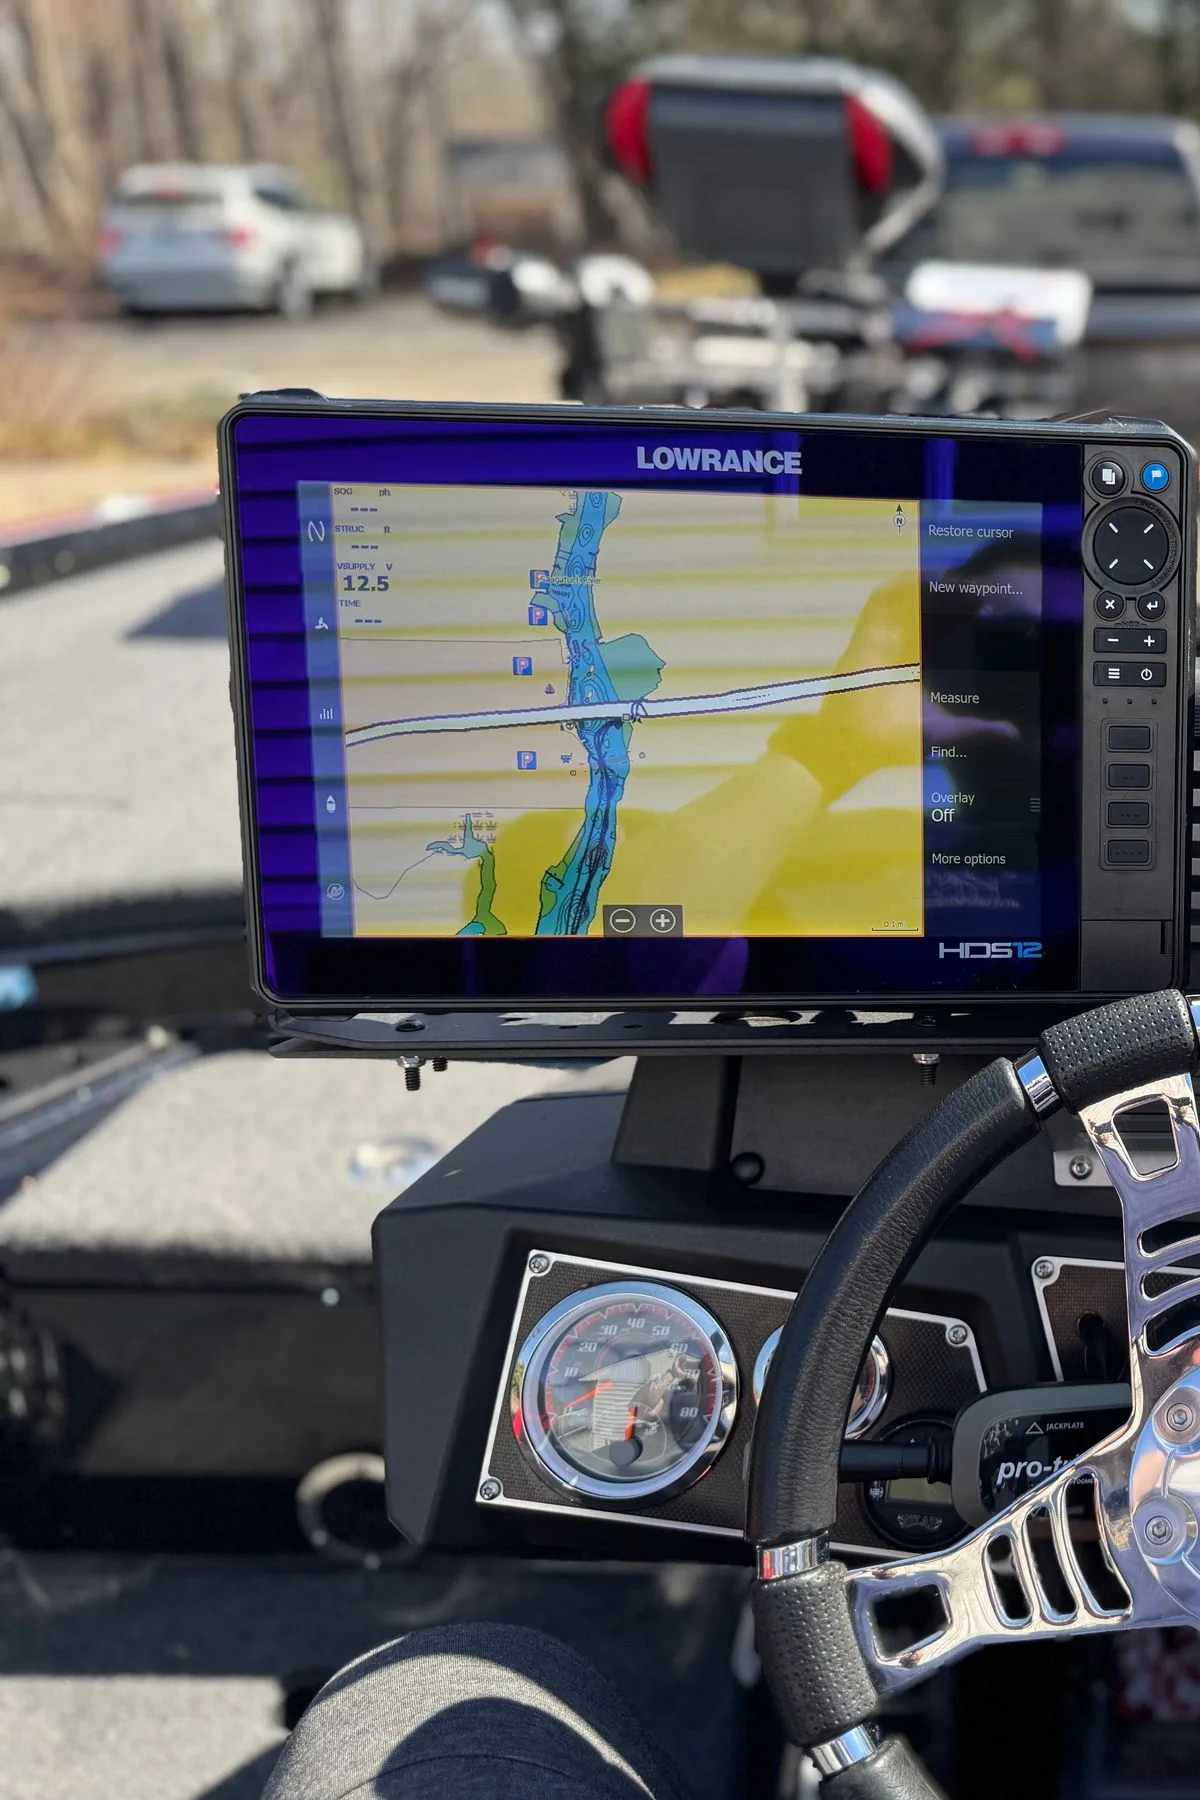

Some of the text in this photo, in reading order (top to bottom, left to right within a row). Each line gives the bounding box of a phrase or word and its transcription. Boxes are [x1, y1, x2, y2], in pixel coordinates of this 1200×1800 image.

[637, 446, 803, 475] LOWRANCE
[335, 525, 364, 533] STRUC
[928, 524, 1014, 538] Restore cursor
[386, 563, 393, 571] V
[343, 575, 389, 592] 12.5
[929, 581, 1023, 596] New waypoint...
[340, 599, 361, 607] TIME
[930, 691, 980, 704] Measure
[931, 747, 967, 758] Find...
[931, 791, 975, 806] Overlay
[932, 808, 955, 823] Off
[932, 853, 1006, 867] More options
[939, 942, 1042, 959] HDS12
[627, 1318, 646, 1329] 40
[600, 1325, 618, 1336] 30
[652, 1326, 671, 1336] 50
[578, 1342, 598, 1353] 20
[564, 1367, 579, 1378] 10
[680, 1406, 698, 1417] 80
[1046, 1422, 1084, 1431] JACKPLATE
[996, 1455, 1075, 1486] pro-t
